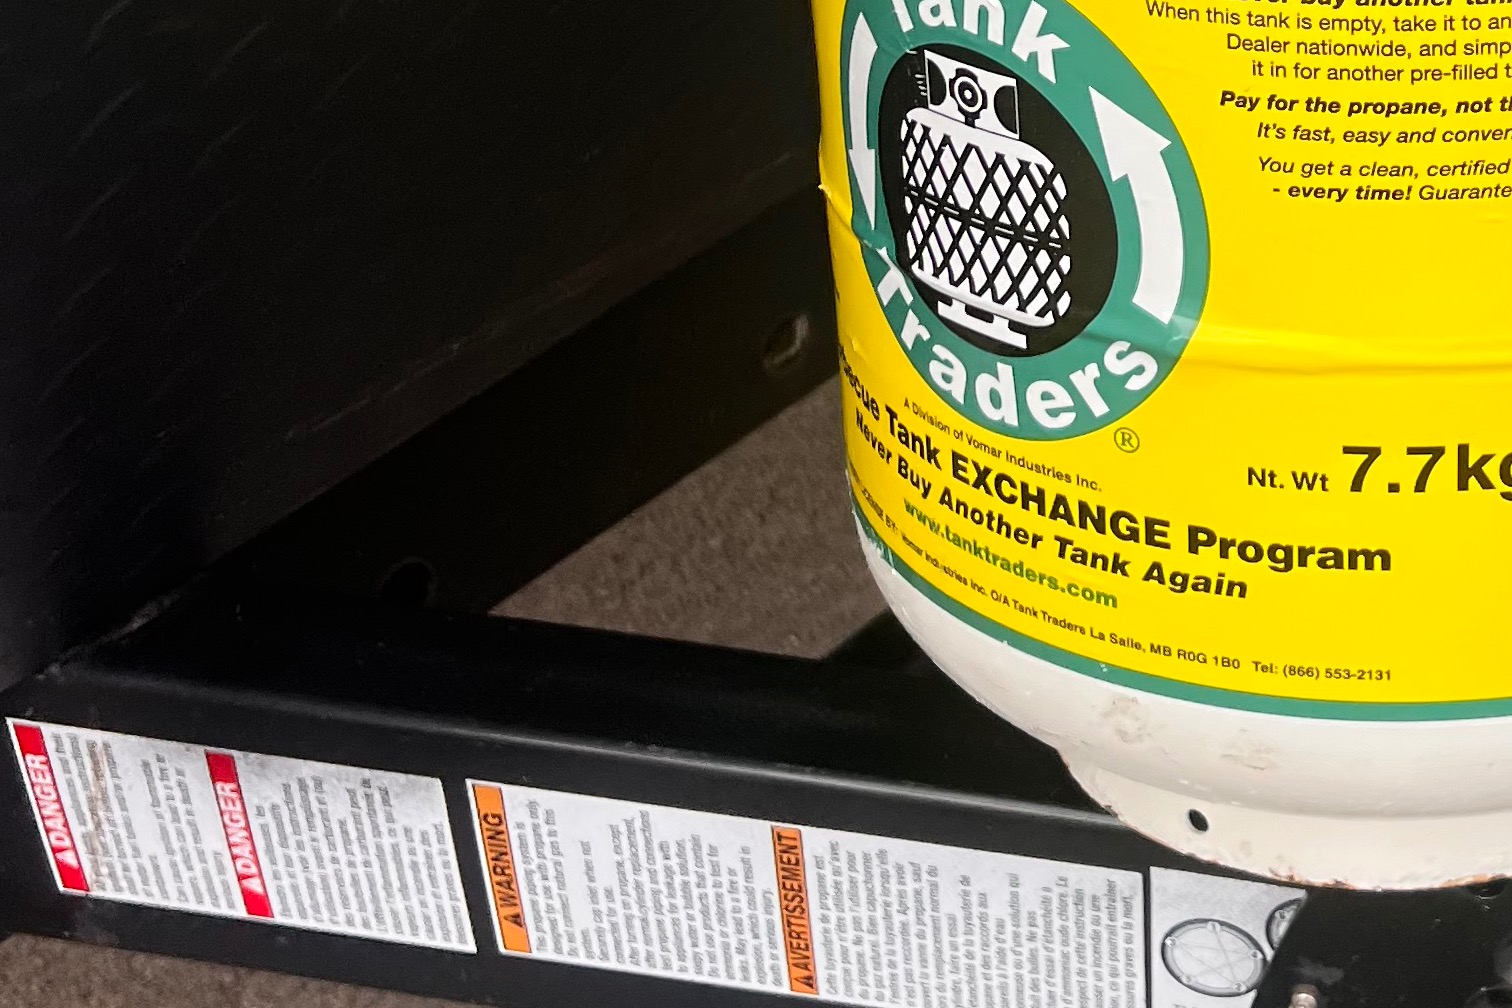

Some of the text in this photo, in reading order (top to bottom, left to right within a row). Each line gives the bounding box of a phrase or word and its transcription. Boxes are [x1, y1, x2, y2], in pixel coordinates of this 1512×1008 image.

[1146, 0, 1199, 21] When
[1206, 7, 1240, 25] this
[1247, 11, 1289, 28] tank
[1297, 13, 1312, 29] is
[1319, 16, 1385, 36] empty,
[1393, 15, 1436, 32] take
[1444, 15, 1455, 31] it
[1461, 15, 1481, 30] to
[1227, 33, 1290, 53] Dealer
[1297, 39, 1411, 59] nationwide,
[1419, 40, 1456, 56] and
[1220, 90, 1260, 112] Pay
[1267, 94, 1299, 111] for
[1305, 97, 1341, 113] the
[1348, 102, 1447, 118] propane,
[1455, 97, 1493, 113] not
[1252, 60, 1264, 76] it
[1271, 61, 1286, 78] in
[1293, 62, 1321, 79] for
[1327, 65, 1404, 81] another
[1411, 63, 1498, 85] pre-filled
[1258, 122, 1286, 139] It's
[1293, 125, 1334, 144] fast,
[1343, 131, 1391, 147] easy
[1396, 127, 1436, 143] and
[1259, 156, 1294, 173] You
[1301, 161, 1334, 178] get
[1340, 165, 1352, 176] a
[1359, 162, 1418, 179] clean,
[1427, 159, 1511, 176] certified
[1288, 186, 1349, 202] every
[1356, 185, 1412, 200] time!
[876, 246, 1158, 428] Traders
[885, 404, 942, 471] Tank
[951, 449, 1171, 550] EXCHANGE
[1188, 525, 1391, 573] Program
[904, 398, 1101, 492] A Division of Vomar Industries Inc.
[1248, 467, 1284, 489] Nt.
[1291, 471, 1329, 492] Wt
[855, 407, 893, 465] Never
[897, 453, 932, 500] Buy
[939, 486, 1043, 549] Another
[1054, 535, 1130, 578] Tank
[1142, 561, 1247, 598] Again
[904, 498, 1118, 608] www.tanktraders.com
[991, 590, 1010, 607] O/A
[1012, 599, 1038, 618] Tank
[1041, 610, 1085, 635] Traders
[1090, 627, 1105, 641] La
[1110, 633, 1145, 653] Salle,
[1150, 643, 1172, 656] MB
[1252, 661, 1278, 675] Tel:
[1283, 664, 1319, 680] (866)
[1325, 668, 1390, 680] 553-2131
[25, 753, 73, 848] DANGER
[216, 781, 259, 878] DANGER
[483, 813, 518, 908] WARNING
[777, 831, 811, 972] AVERTISSEMENT
